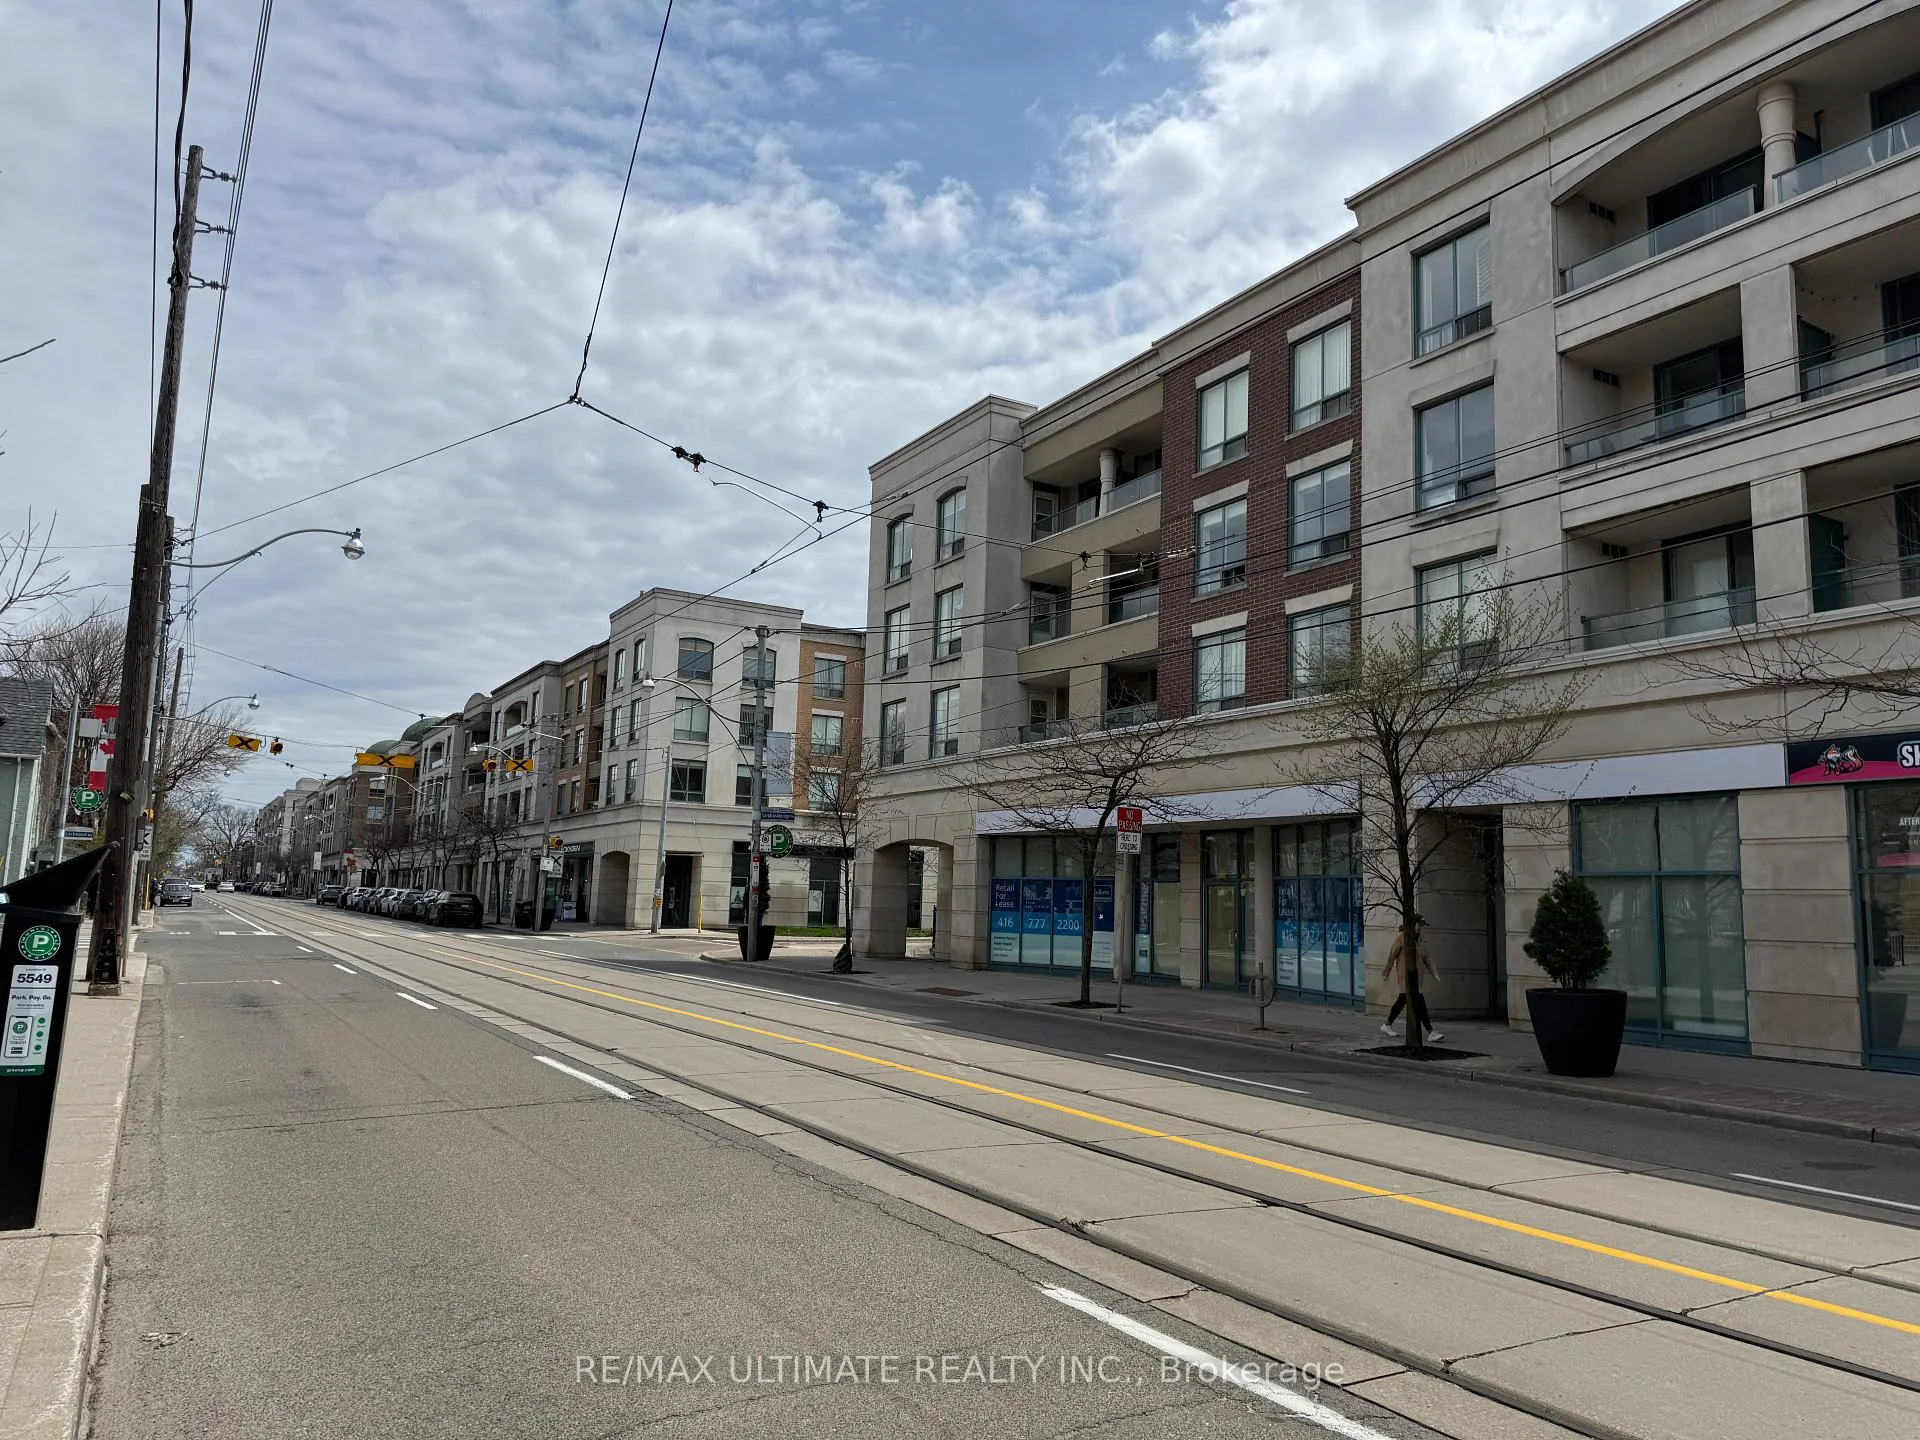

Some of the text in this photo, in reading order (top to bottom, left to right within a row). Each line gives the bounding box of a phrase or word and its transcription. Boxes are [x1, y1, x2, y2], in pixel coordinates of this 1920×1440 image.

[81, 791, 95, 802] P
[1126, 810, 1134, 820] NO
[1118, 820, 1141, 832] PASSING
[772, 834, 785, 846] P
[996, 884, 1015, 892] Retail
[997, 918, 1080, 930] 416 777 2200
[32, 934, 50, 948] P
[17, 973, 52, 984] 5549
